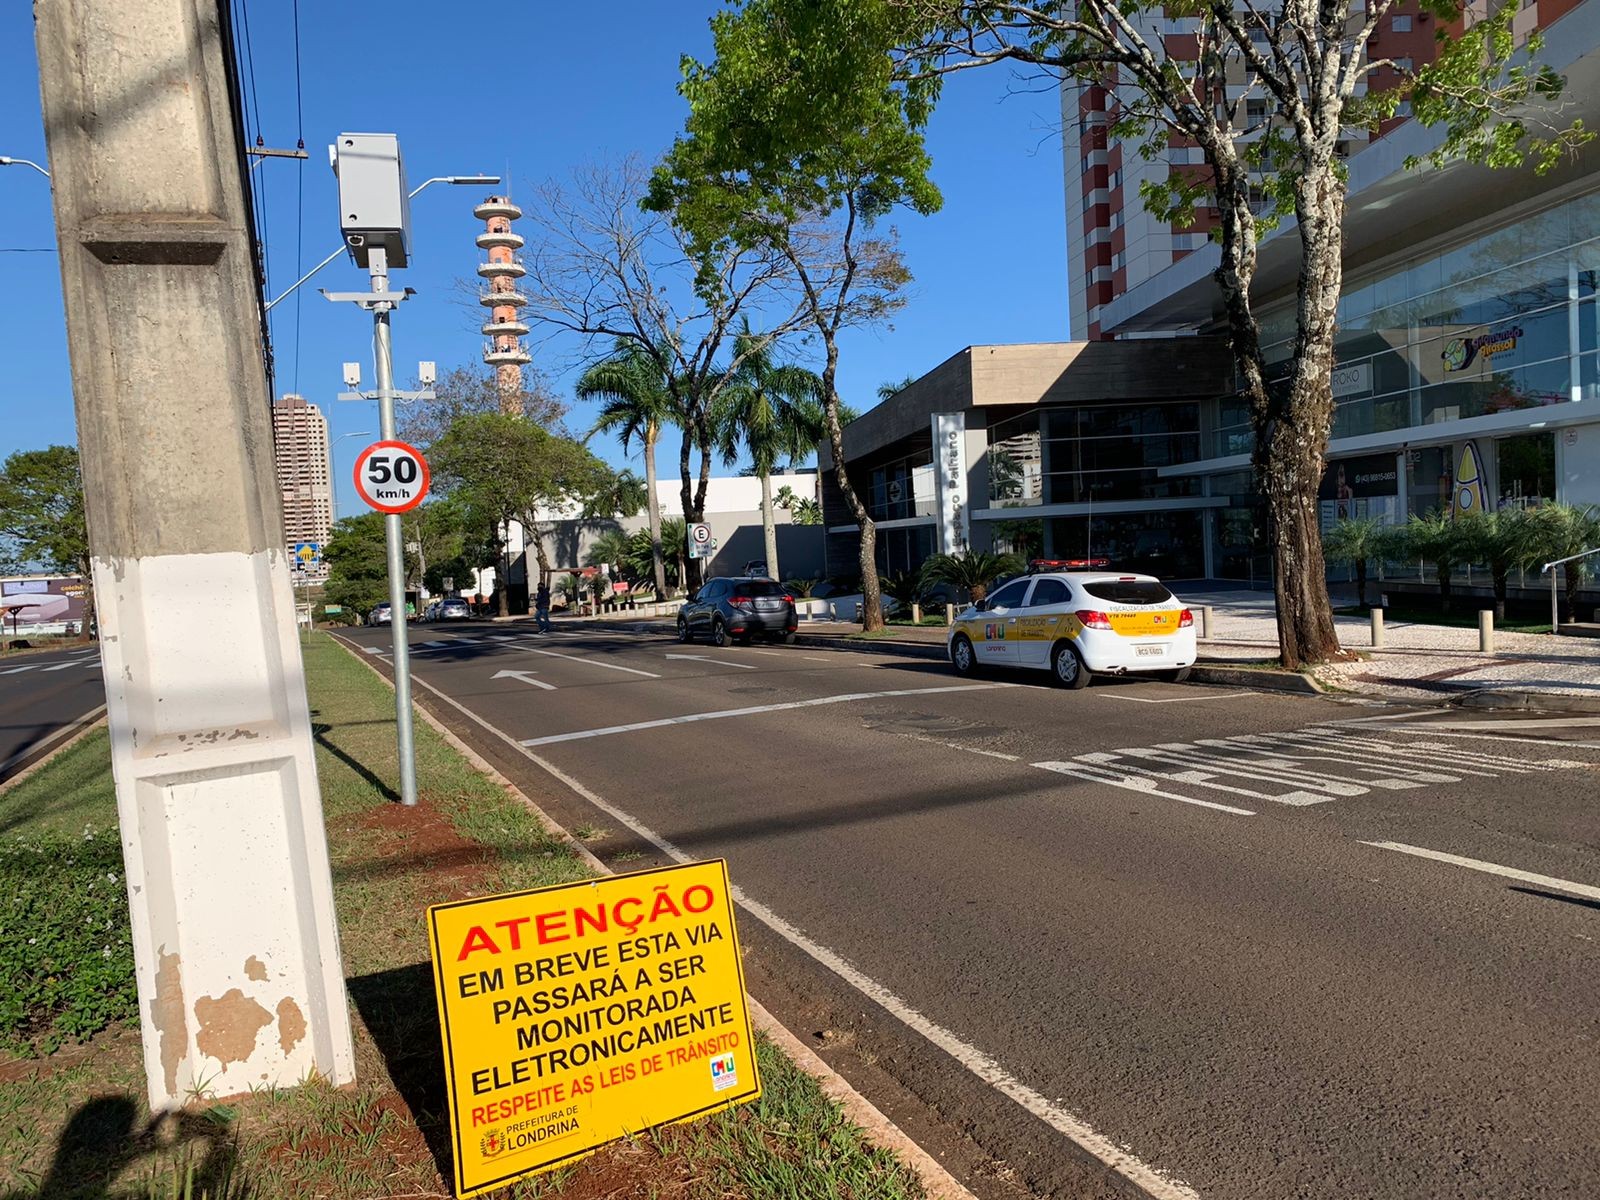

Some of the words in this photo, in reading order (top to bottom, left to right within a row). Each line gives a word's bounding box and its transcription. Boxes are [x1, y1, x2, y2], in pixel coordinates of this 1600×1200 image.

[368, 456, 417, 484] 50
[376, 489, 410, 498] km/h
[698, 530, 704, 539] E
[457, 884, 715, 962] ATENÇÃO
[459, 971, 504, 998] EM
[515, 946, 608, 986] BREVE
[619, 933, 680, 962] ESTA
[685, 922, 723, 946] VIA
[492, 968, 627, 1024] PASSARÁ
[635, 971, 653, 990] A
[659, 955, 706, 982] SER
[471, 1002, 734, 1096] ELETRONICAMENTE
[516, 985, 696, 1051] MONITORADA
[472, 1085, 565, 1127] RESPEITE
[570, 1078, 594, 1098] AS
[600, 1064, 636, 1088] LEIS
[642, 1056, 663, 1077] DE
[666, 1031, 739, 1067] TRÂNSITO
[506, 1109, 564, 1134] PREFEITURA
[567, 1105, 579, 1117] DE
[508, 1117, 580, 1150] LONDRINA
